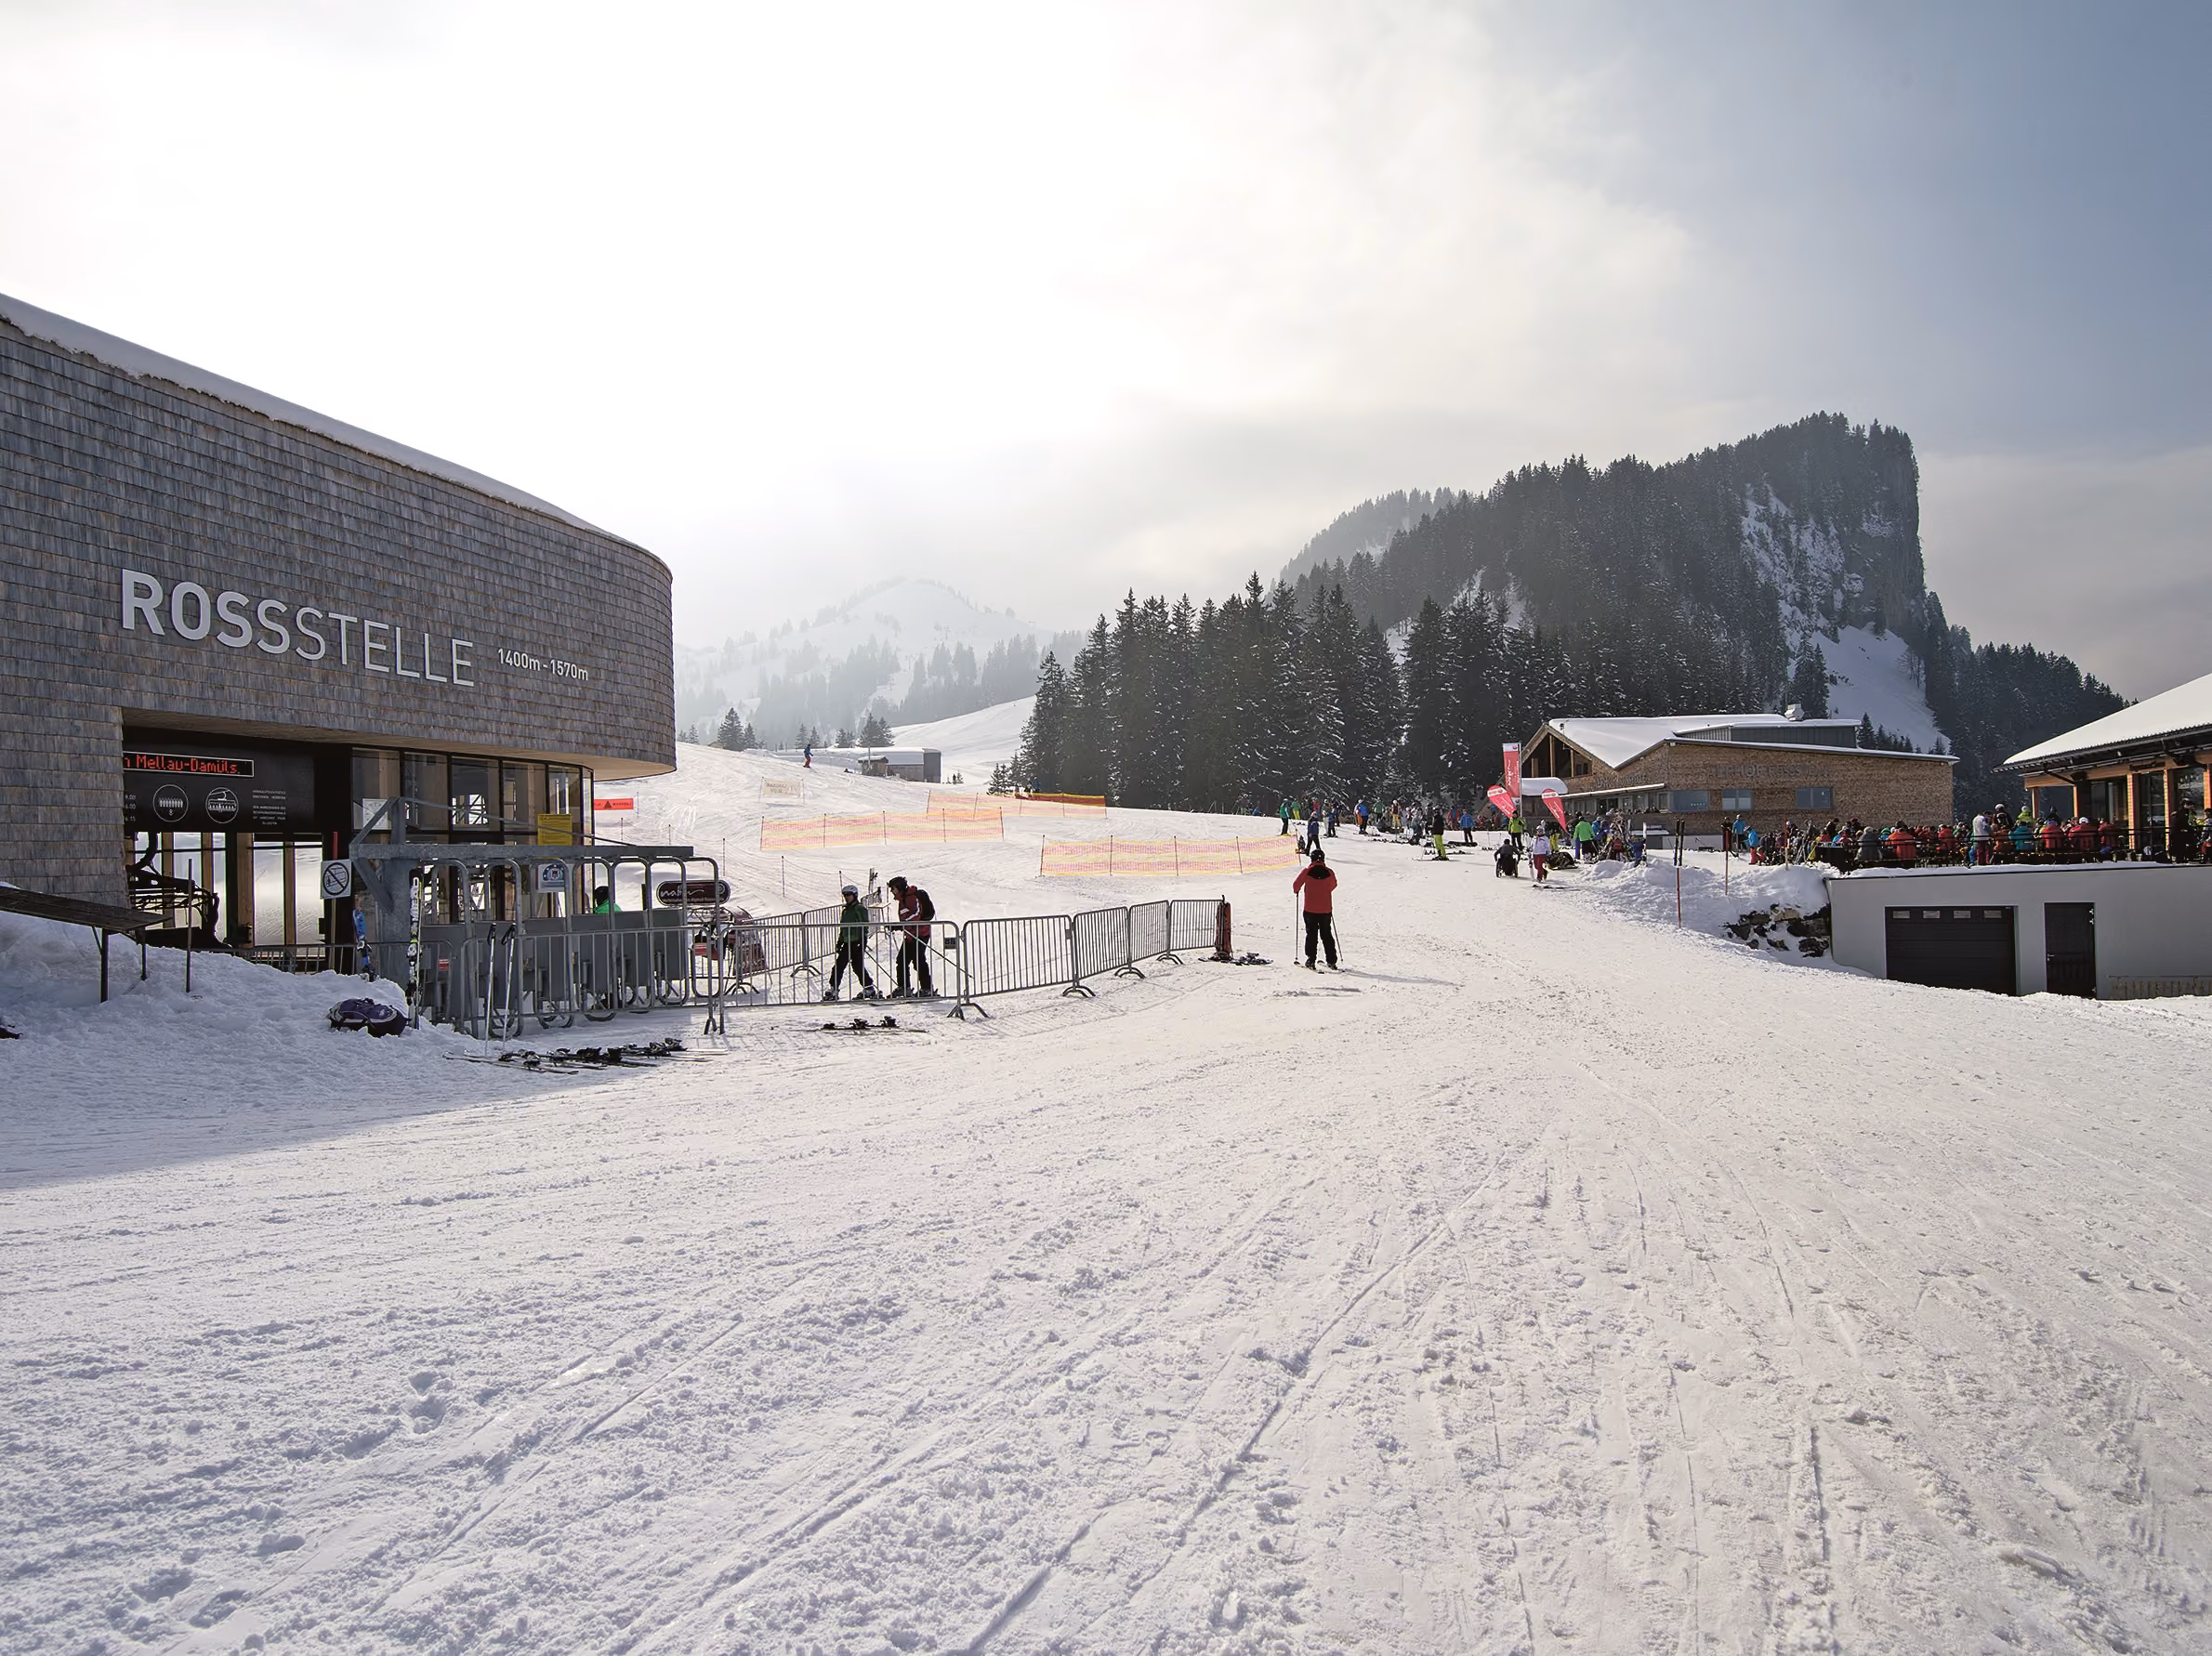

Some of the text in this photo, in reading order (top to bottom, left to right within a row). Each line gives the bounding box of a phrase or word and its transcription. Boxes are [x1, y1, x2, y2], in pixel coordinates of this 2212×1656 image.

[122, 569, 475, 687] ROSSSTELLE
[497, 648, 540, 671] 1400m
[550, 659, 588, 681] 1570m
